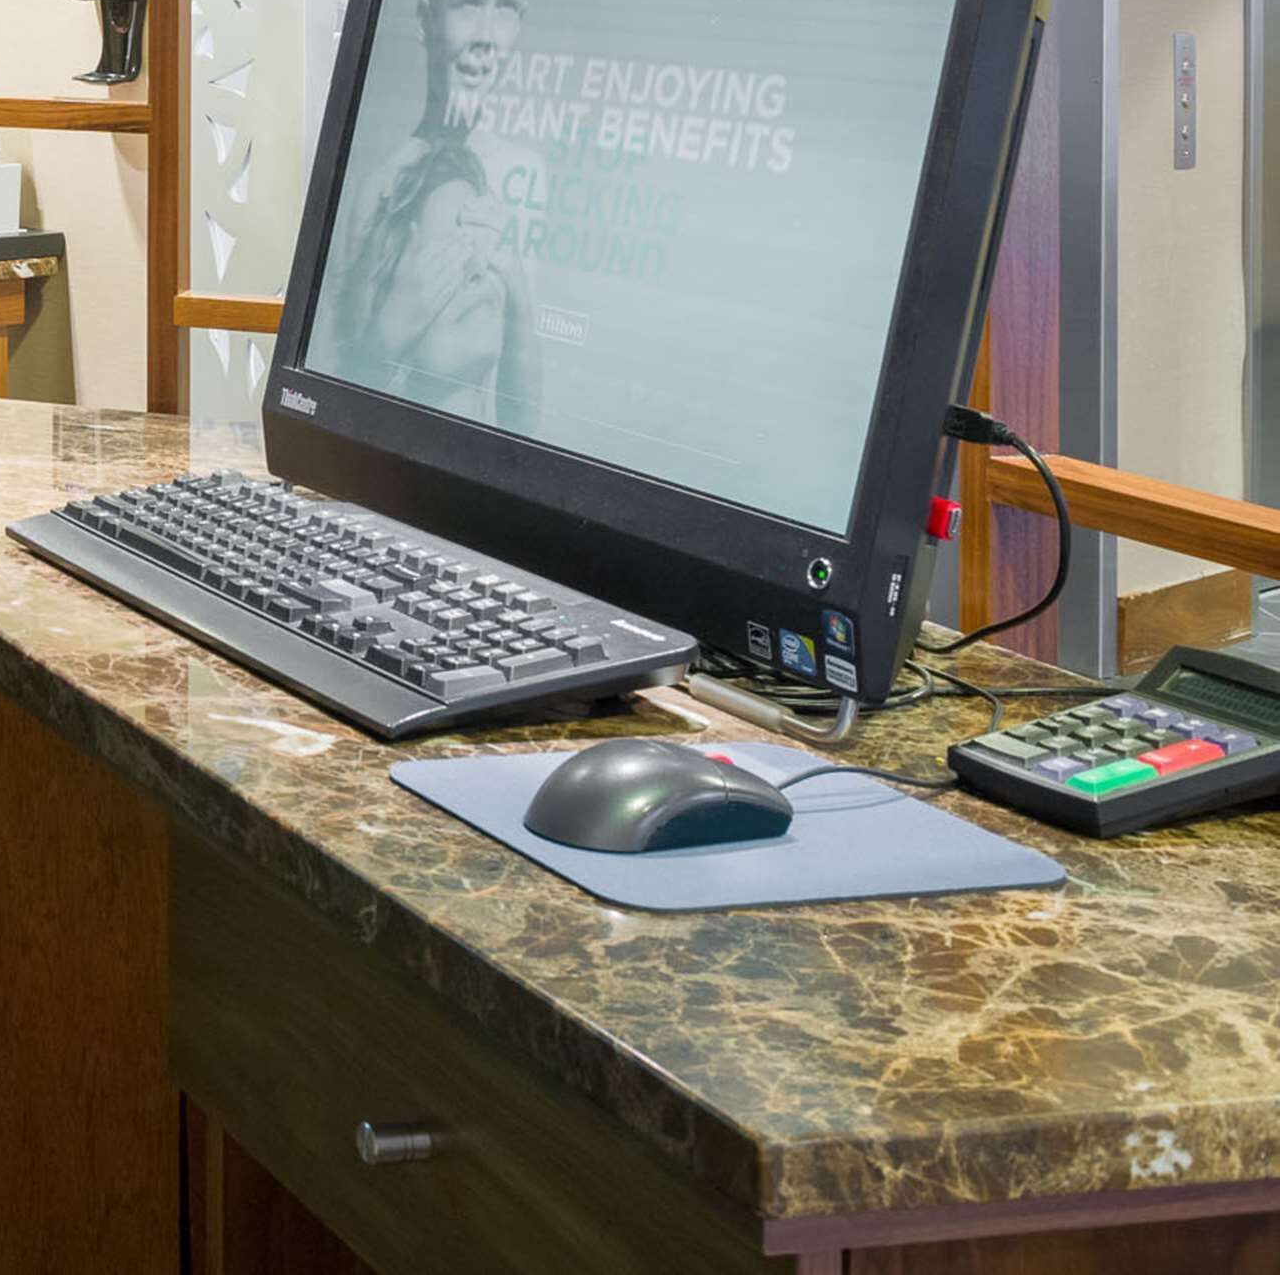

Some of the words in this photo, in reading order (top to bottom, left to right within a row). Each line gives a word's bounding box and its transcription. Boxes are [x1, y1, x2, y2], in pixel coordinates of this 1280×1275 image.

[581, 57, 787, 119] ENJOYING
[443, 90, 591, 144] INSTANT
[595, 107, 796, 175] BENEFITS
[502, 165, 685, 234] CLICKING
[495, 214, 671, 281] AROUND
